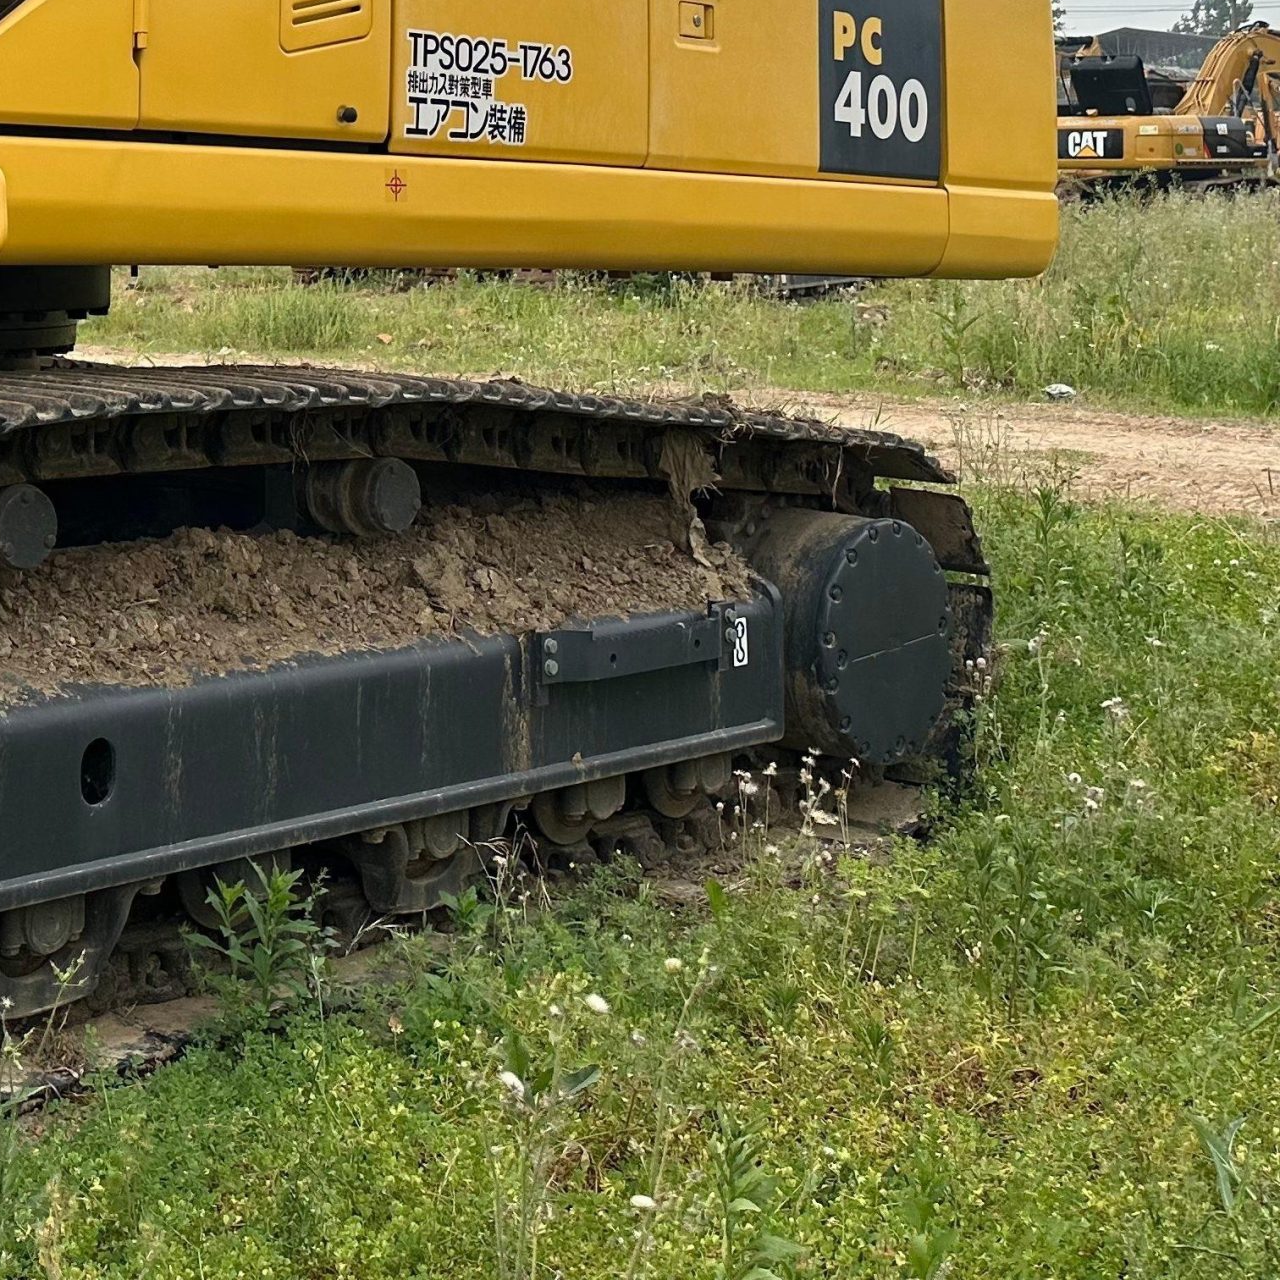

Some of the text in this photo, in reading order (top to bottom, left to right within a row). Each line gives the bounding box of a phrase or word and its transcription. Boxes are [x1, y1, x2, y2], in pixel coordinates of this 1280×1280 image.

[408, 32, 571, 81] TPS025-1763
[833, 10, 883, 66] PC
[405, 96, 526, 143] エアコン装備
[834, 70, 928, 143] 400
[1068, 131, 1108, 157] CAT
